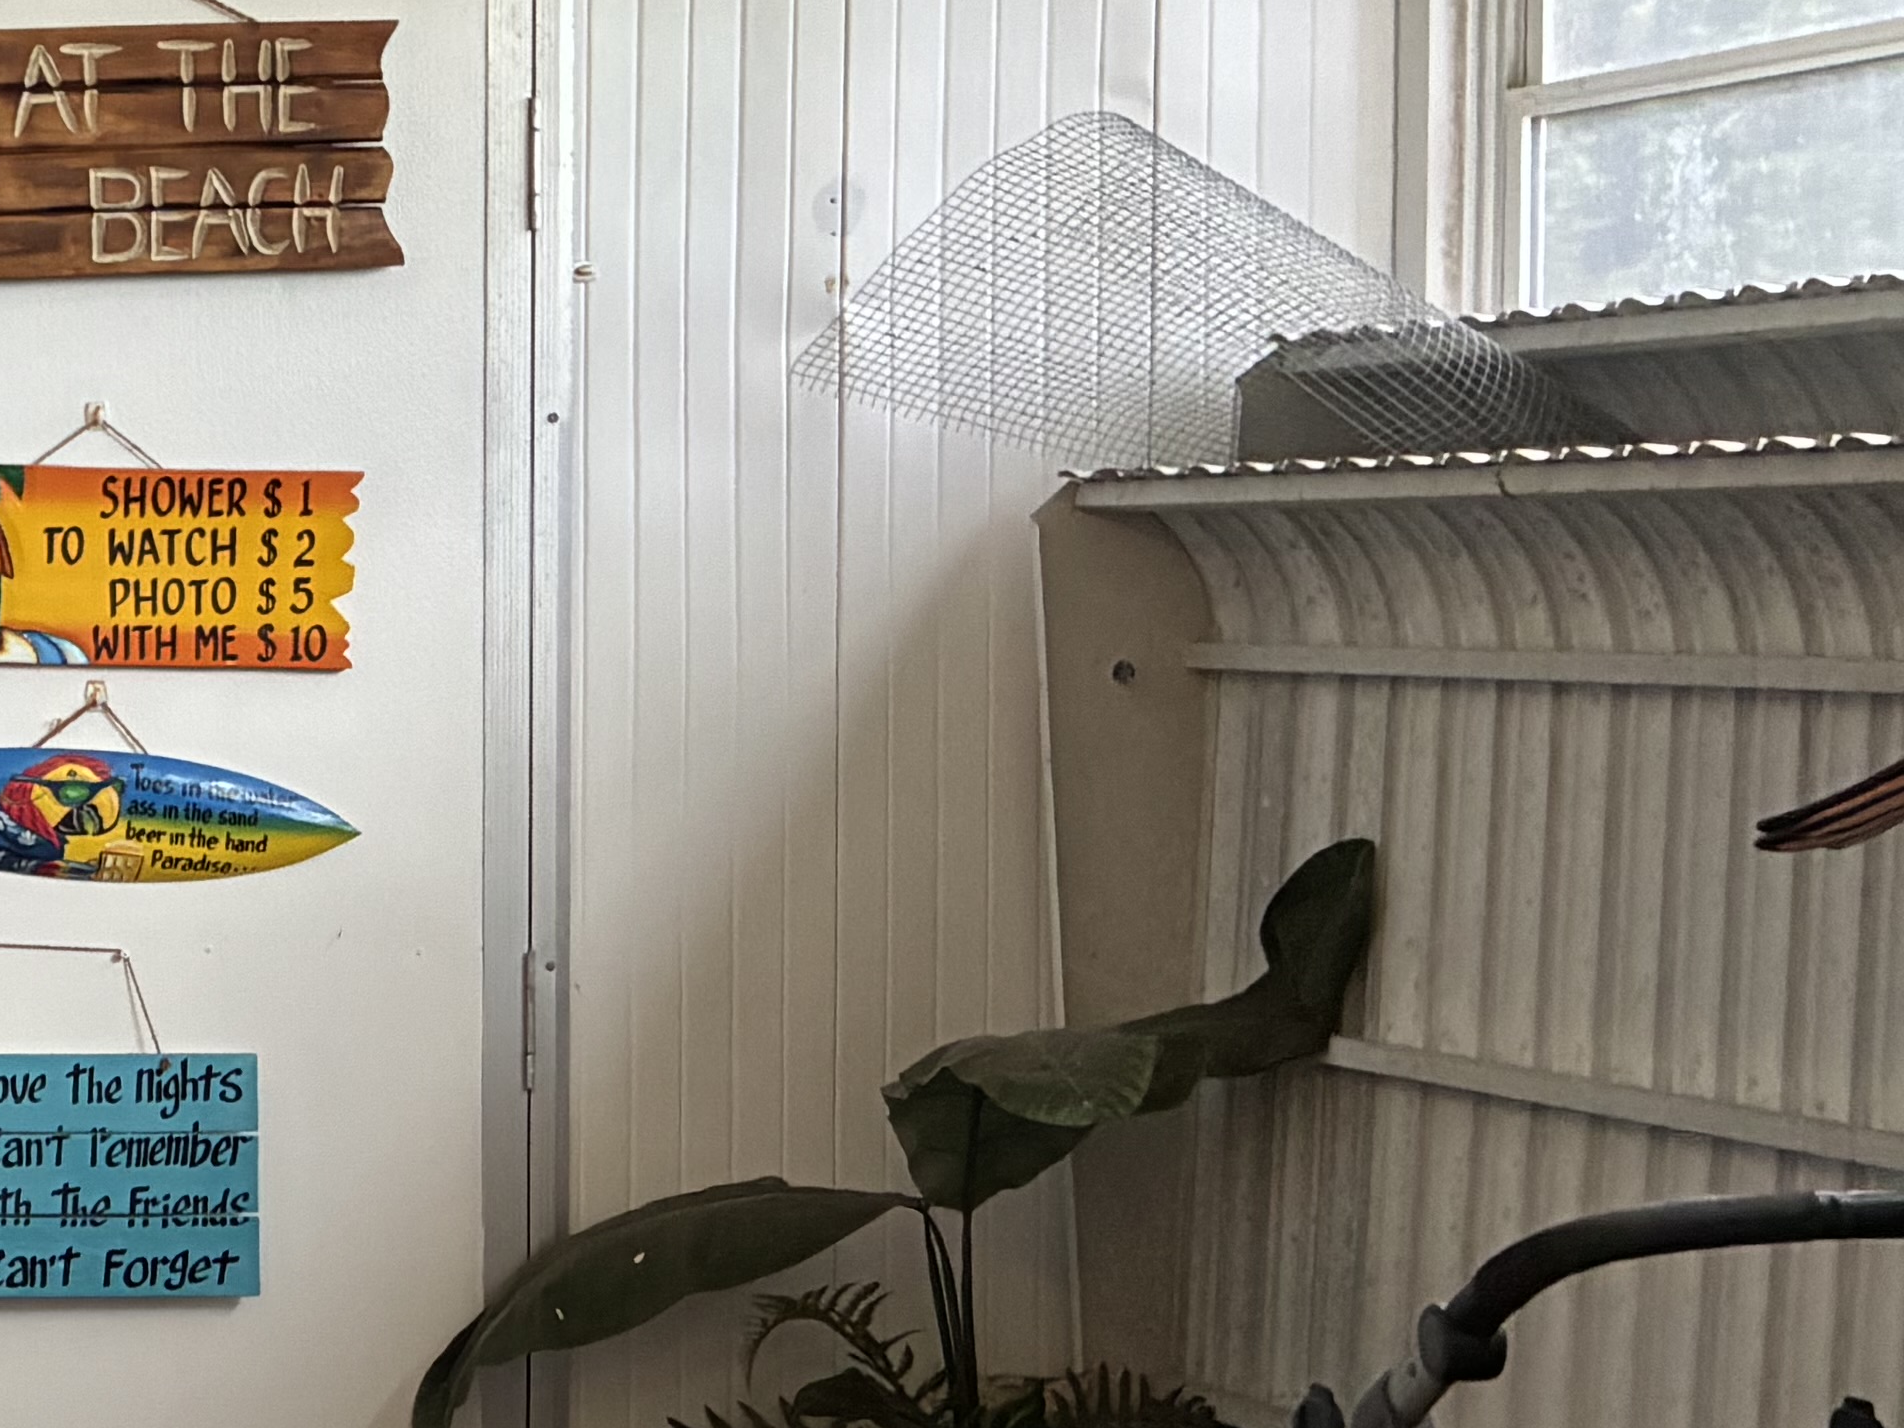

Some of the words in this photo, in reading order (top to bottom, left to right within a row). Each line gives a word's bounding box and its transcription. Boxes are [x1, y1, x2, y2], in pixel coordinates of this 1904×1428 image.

[14, 42, 123, 139] AT
[157, 37, 316, 135] THE
[89, 163, 345, 263] BEACH
[100, 476, 247, 520] SHOWER
[43, 526, 85, 566] TO
[107, 527, 238, 568] WATCH
[109, 577, 238, 618] PHOTO
[92, 625, 179, 663] WITH
[194, 626, 239, 662] ME
[130, 763, 175, 795] Toes
[181, 781, 202, 799] in
[127, 798, 157, 818] ass
[163, 803, 179, 821] in
[184, 800, 213, 823] the
[218, 808, 259, 827] sand
[125, 819, 167, 844] beer
[169, 830, 186, 847] in
[188, 825, 220, 850] the
[225, 831, 269, 853] hand
[89, 1122, 254, 1169] remember
[127, 1185, 252, 1229] Friends
[102, 1248, 241, 1291] Forget
